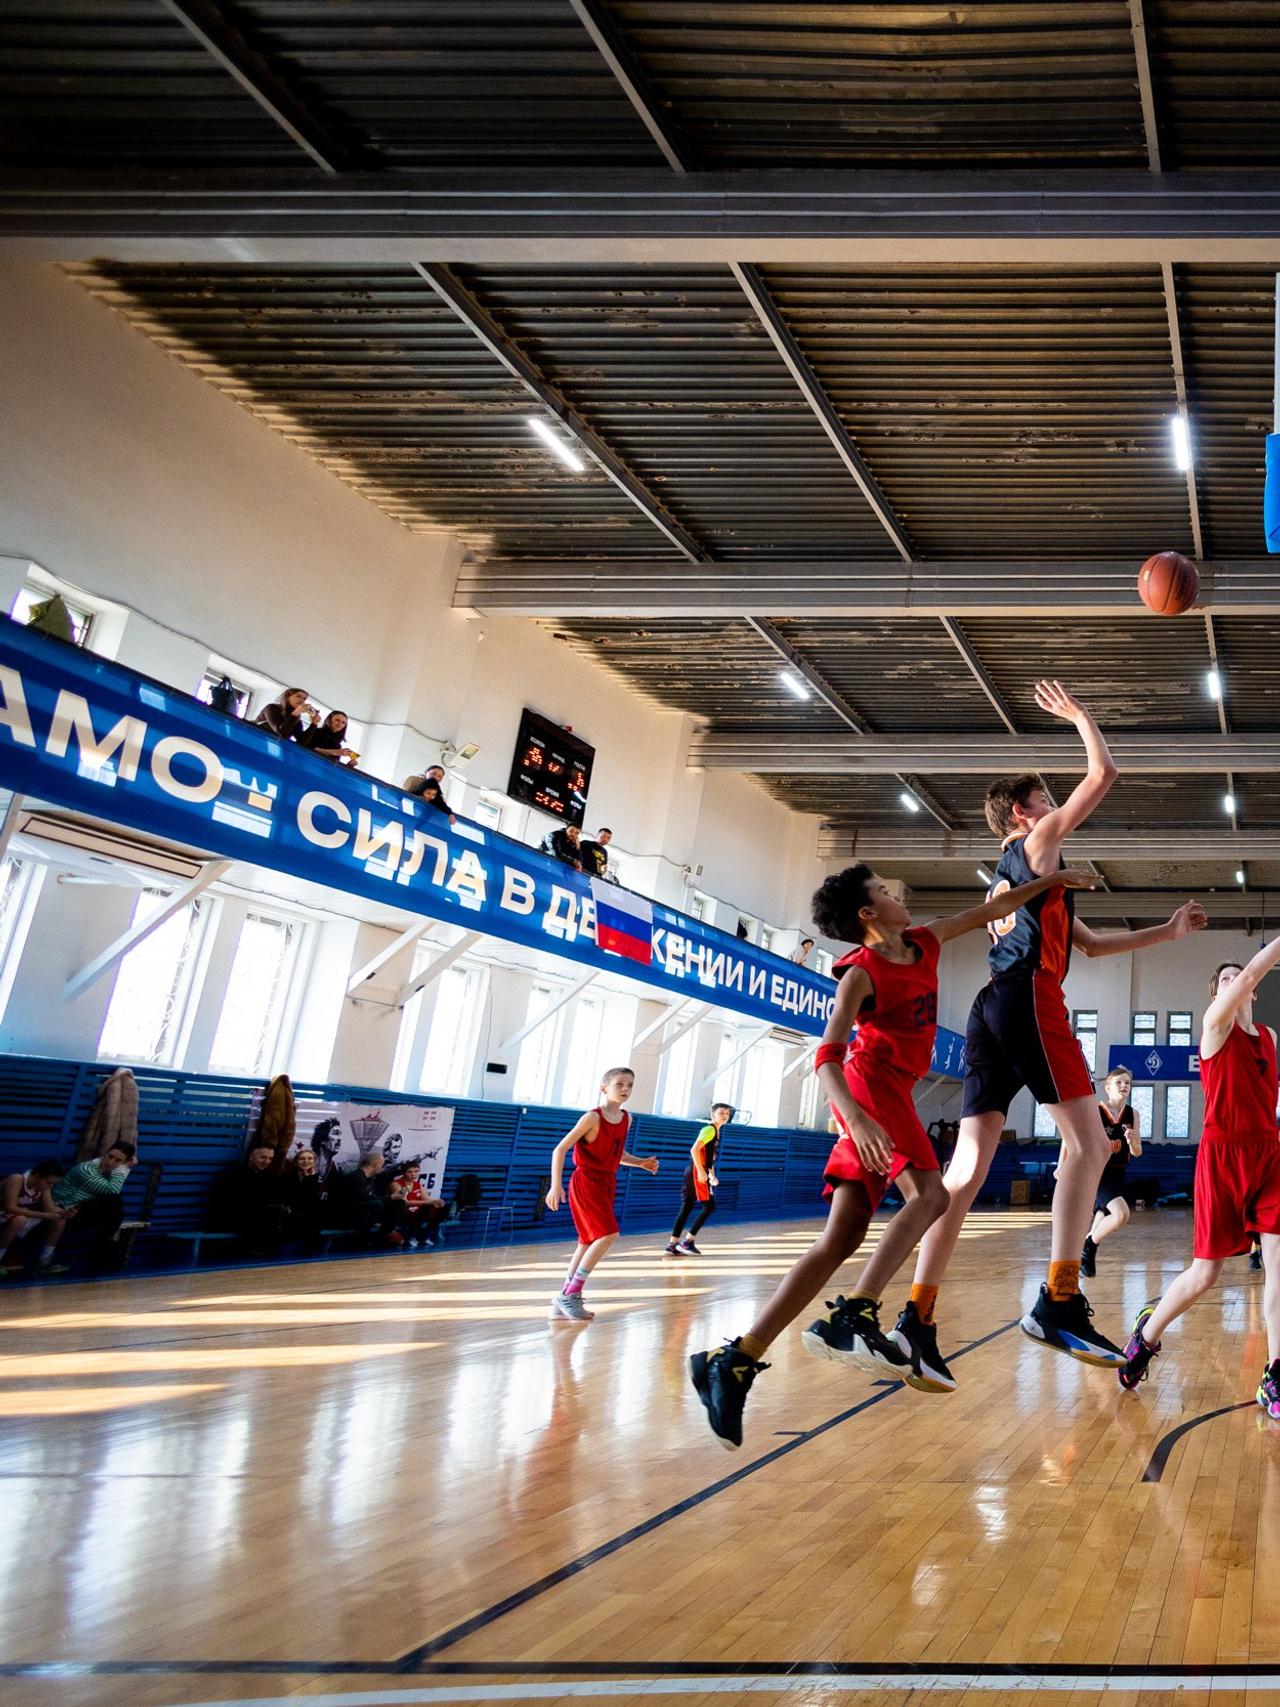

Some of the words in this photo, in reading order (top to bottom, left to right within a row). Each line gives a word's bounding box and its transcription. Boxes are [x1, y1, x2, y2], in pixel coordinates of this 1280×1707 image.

[297, 790, 488, 902] СИЛА
[500, 865, 536, 915] В
[748, 965, 767, 1000] И
